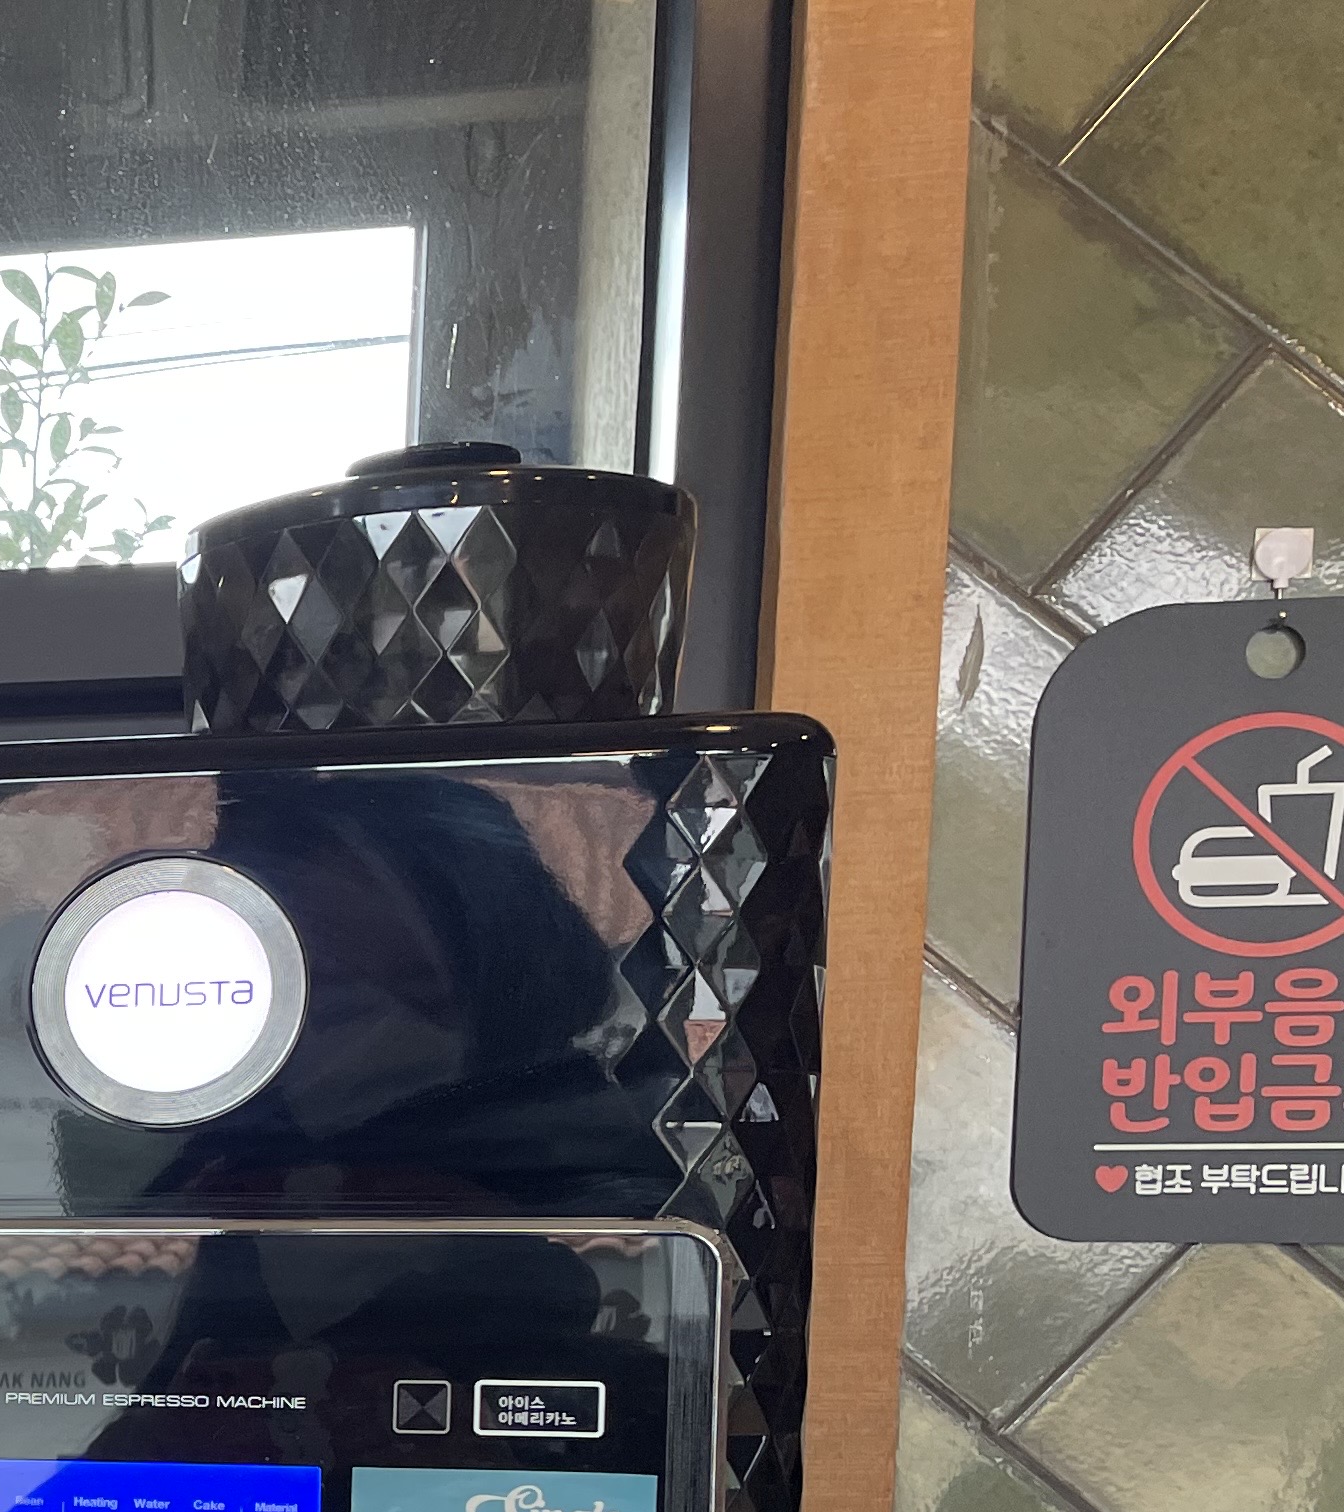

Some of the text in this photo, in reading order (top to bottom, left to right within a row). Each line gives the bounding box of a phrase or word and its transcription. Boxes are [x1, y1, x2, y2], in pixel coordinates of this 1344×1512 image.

[1101, 967, 1344, 1047] 외부음
[1101, 1051, 1344, 1134] 반입금
[1134, 1163, 1194, 1196] 협조
[29, 1369, 87, 1390] NANG
[4, 1391, 307, 1411] PREMIUM ESPRESSO MACHINE
[498, 1395, 546, 1411] 아이스
[497, 1410, 578, 1427] 아메리카노
[73, 1496, 118, 1511] Heating
[133, 1498, 171, 1510] Water
[192, 1499, 226, 1511] Cake
